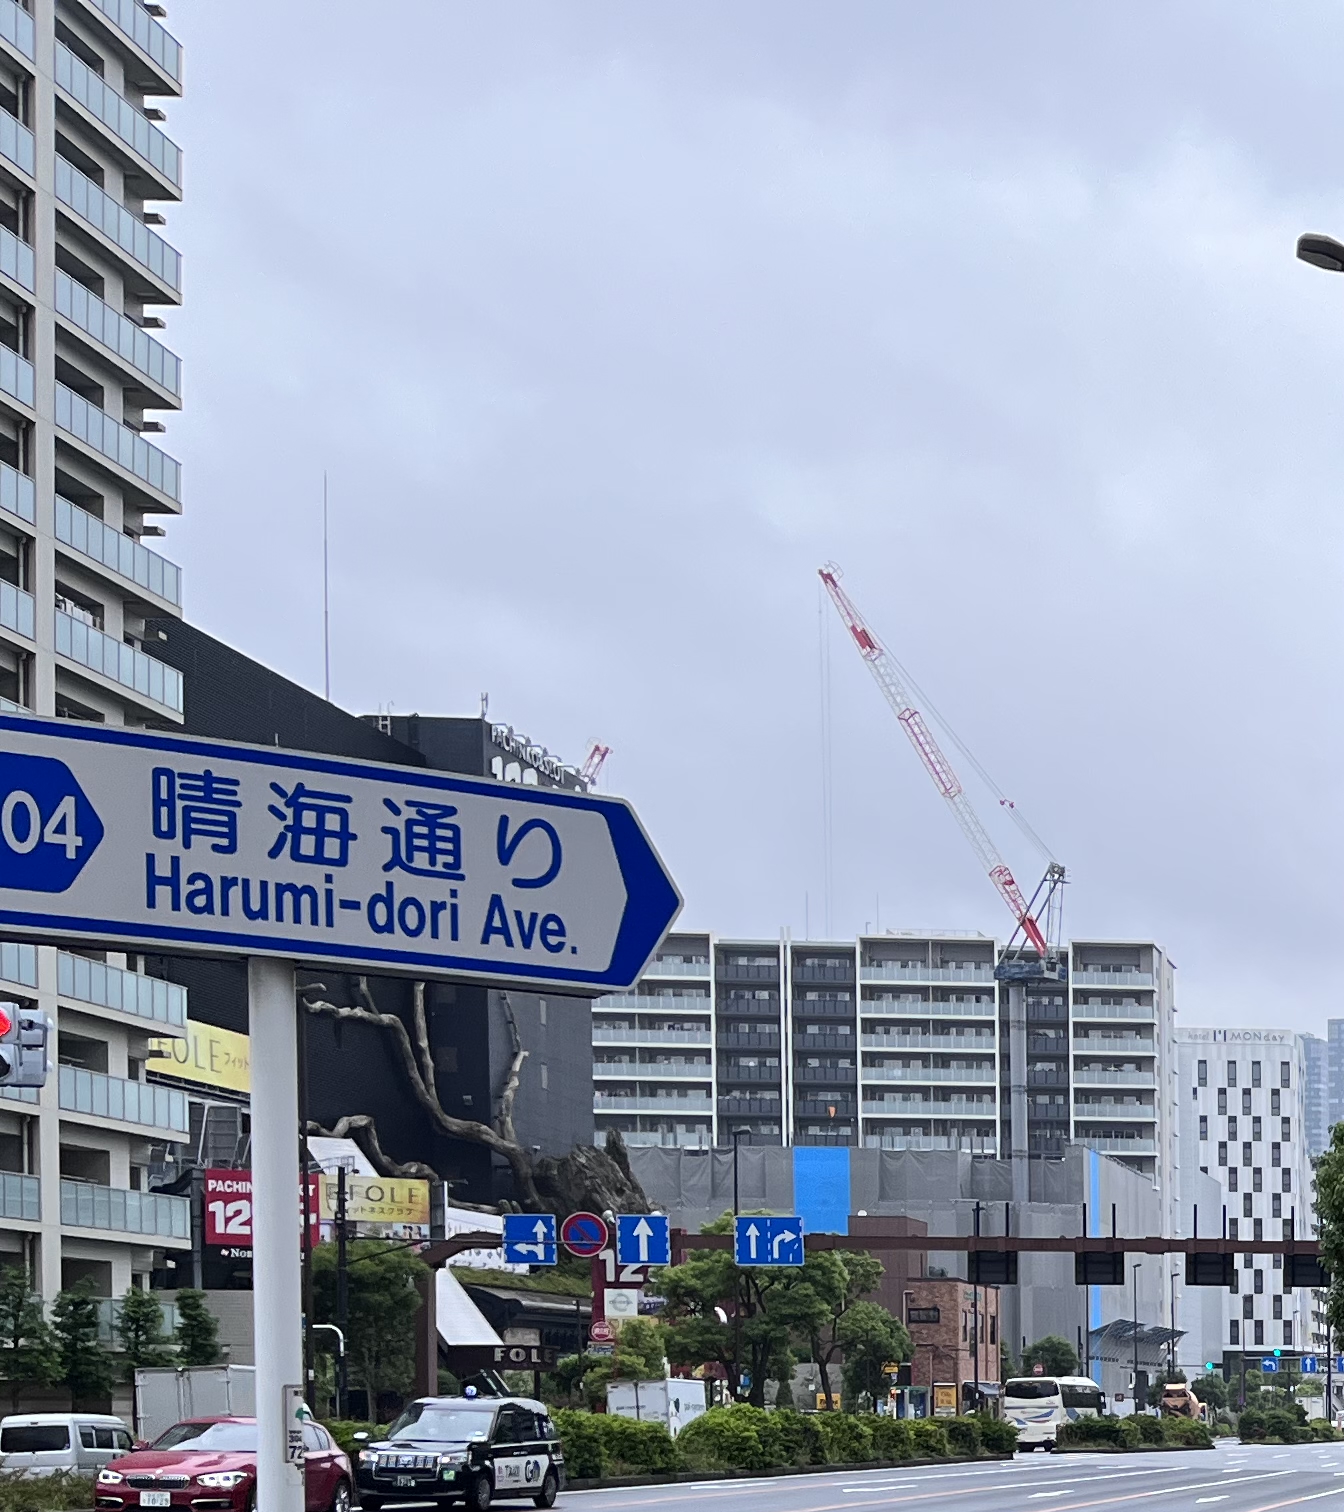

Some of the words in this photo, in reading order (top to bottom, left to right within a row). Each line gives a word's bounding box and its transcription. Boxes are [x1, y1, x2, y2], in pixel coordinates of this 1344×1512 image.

[152, 766, 562, 889] 晴海通り
[145, 852, 459, 942] Harumi-dori
[480, 893, 577, 955] Ave.
[494, 1347, 553, 1363] FOLE
